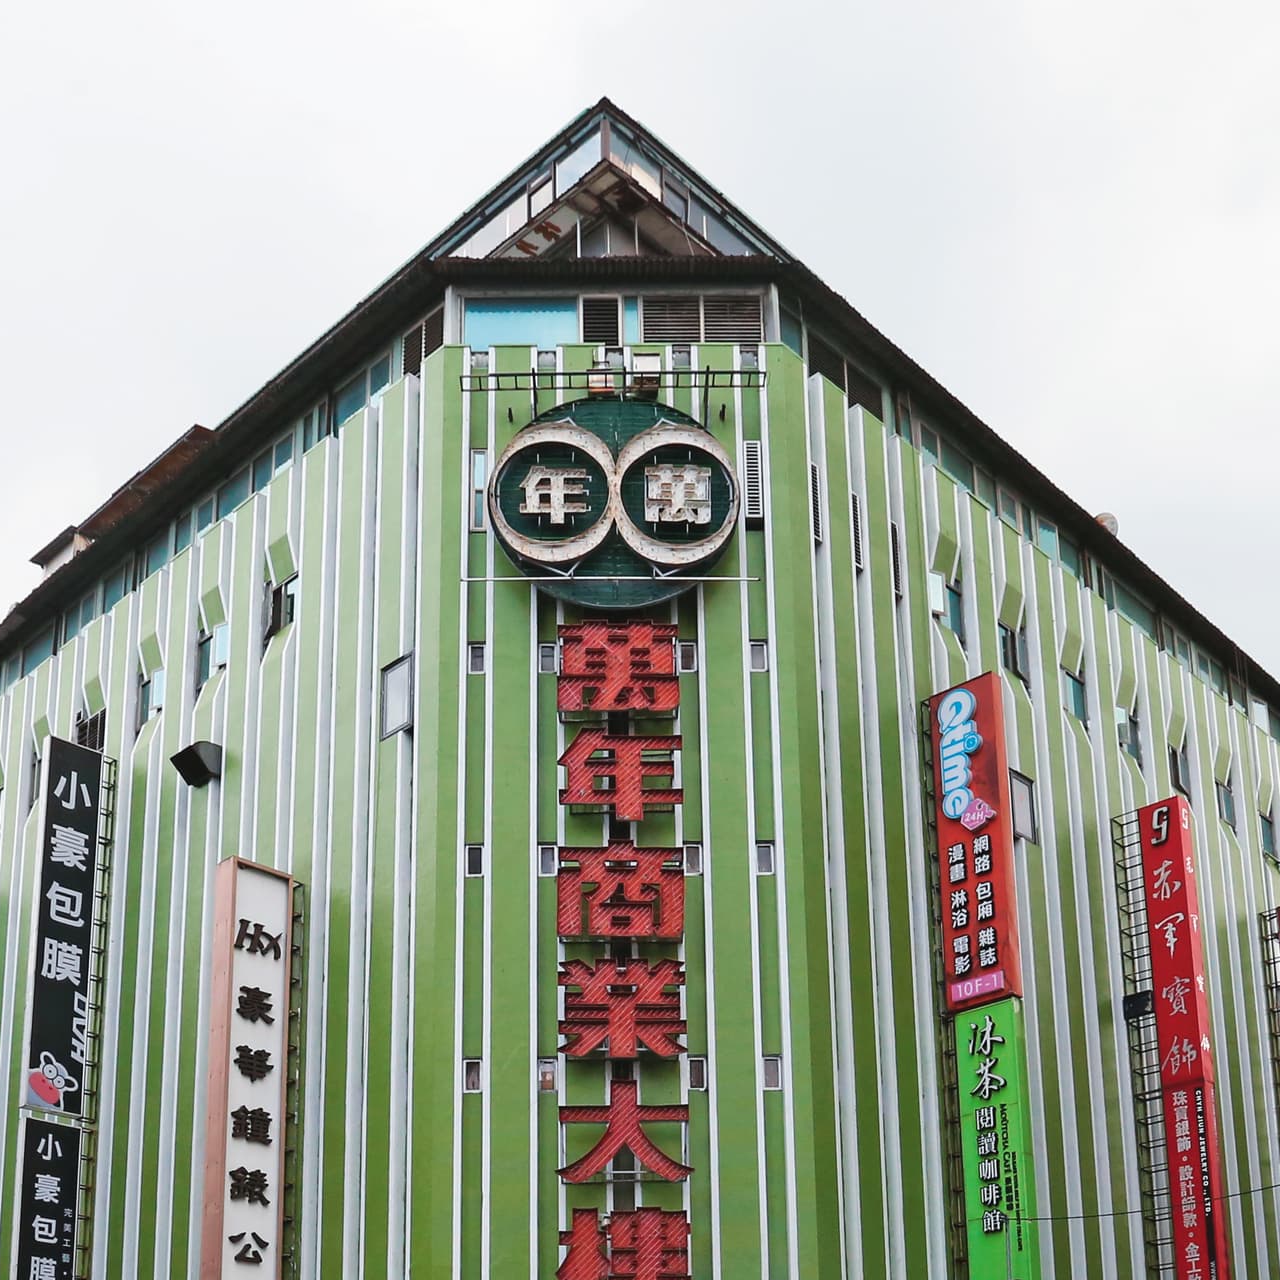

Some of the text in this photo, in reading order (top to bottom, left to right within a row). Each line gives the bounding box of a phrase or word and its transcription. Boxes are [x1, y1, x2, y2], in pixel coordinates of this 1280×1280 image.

[964, 810, 985, 823] 24H
[41, 771, 93, 986] 小豪包膜
[948, 844, 971, 975] 漫畫 淋浴 電影
[972, 835, 998, 968] 網路 包廂 雜誌
[955, 974, 1001, 998] 10F-1
[969, 1016, 1005, 1099] 沐茶
[975, 1107, 1003, 1234] 閱讀咖啡館
[1199, 1136, 1208, 1173] JEWELRY
